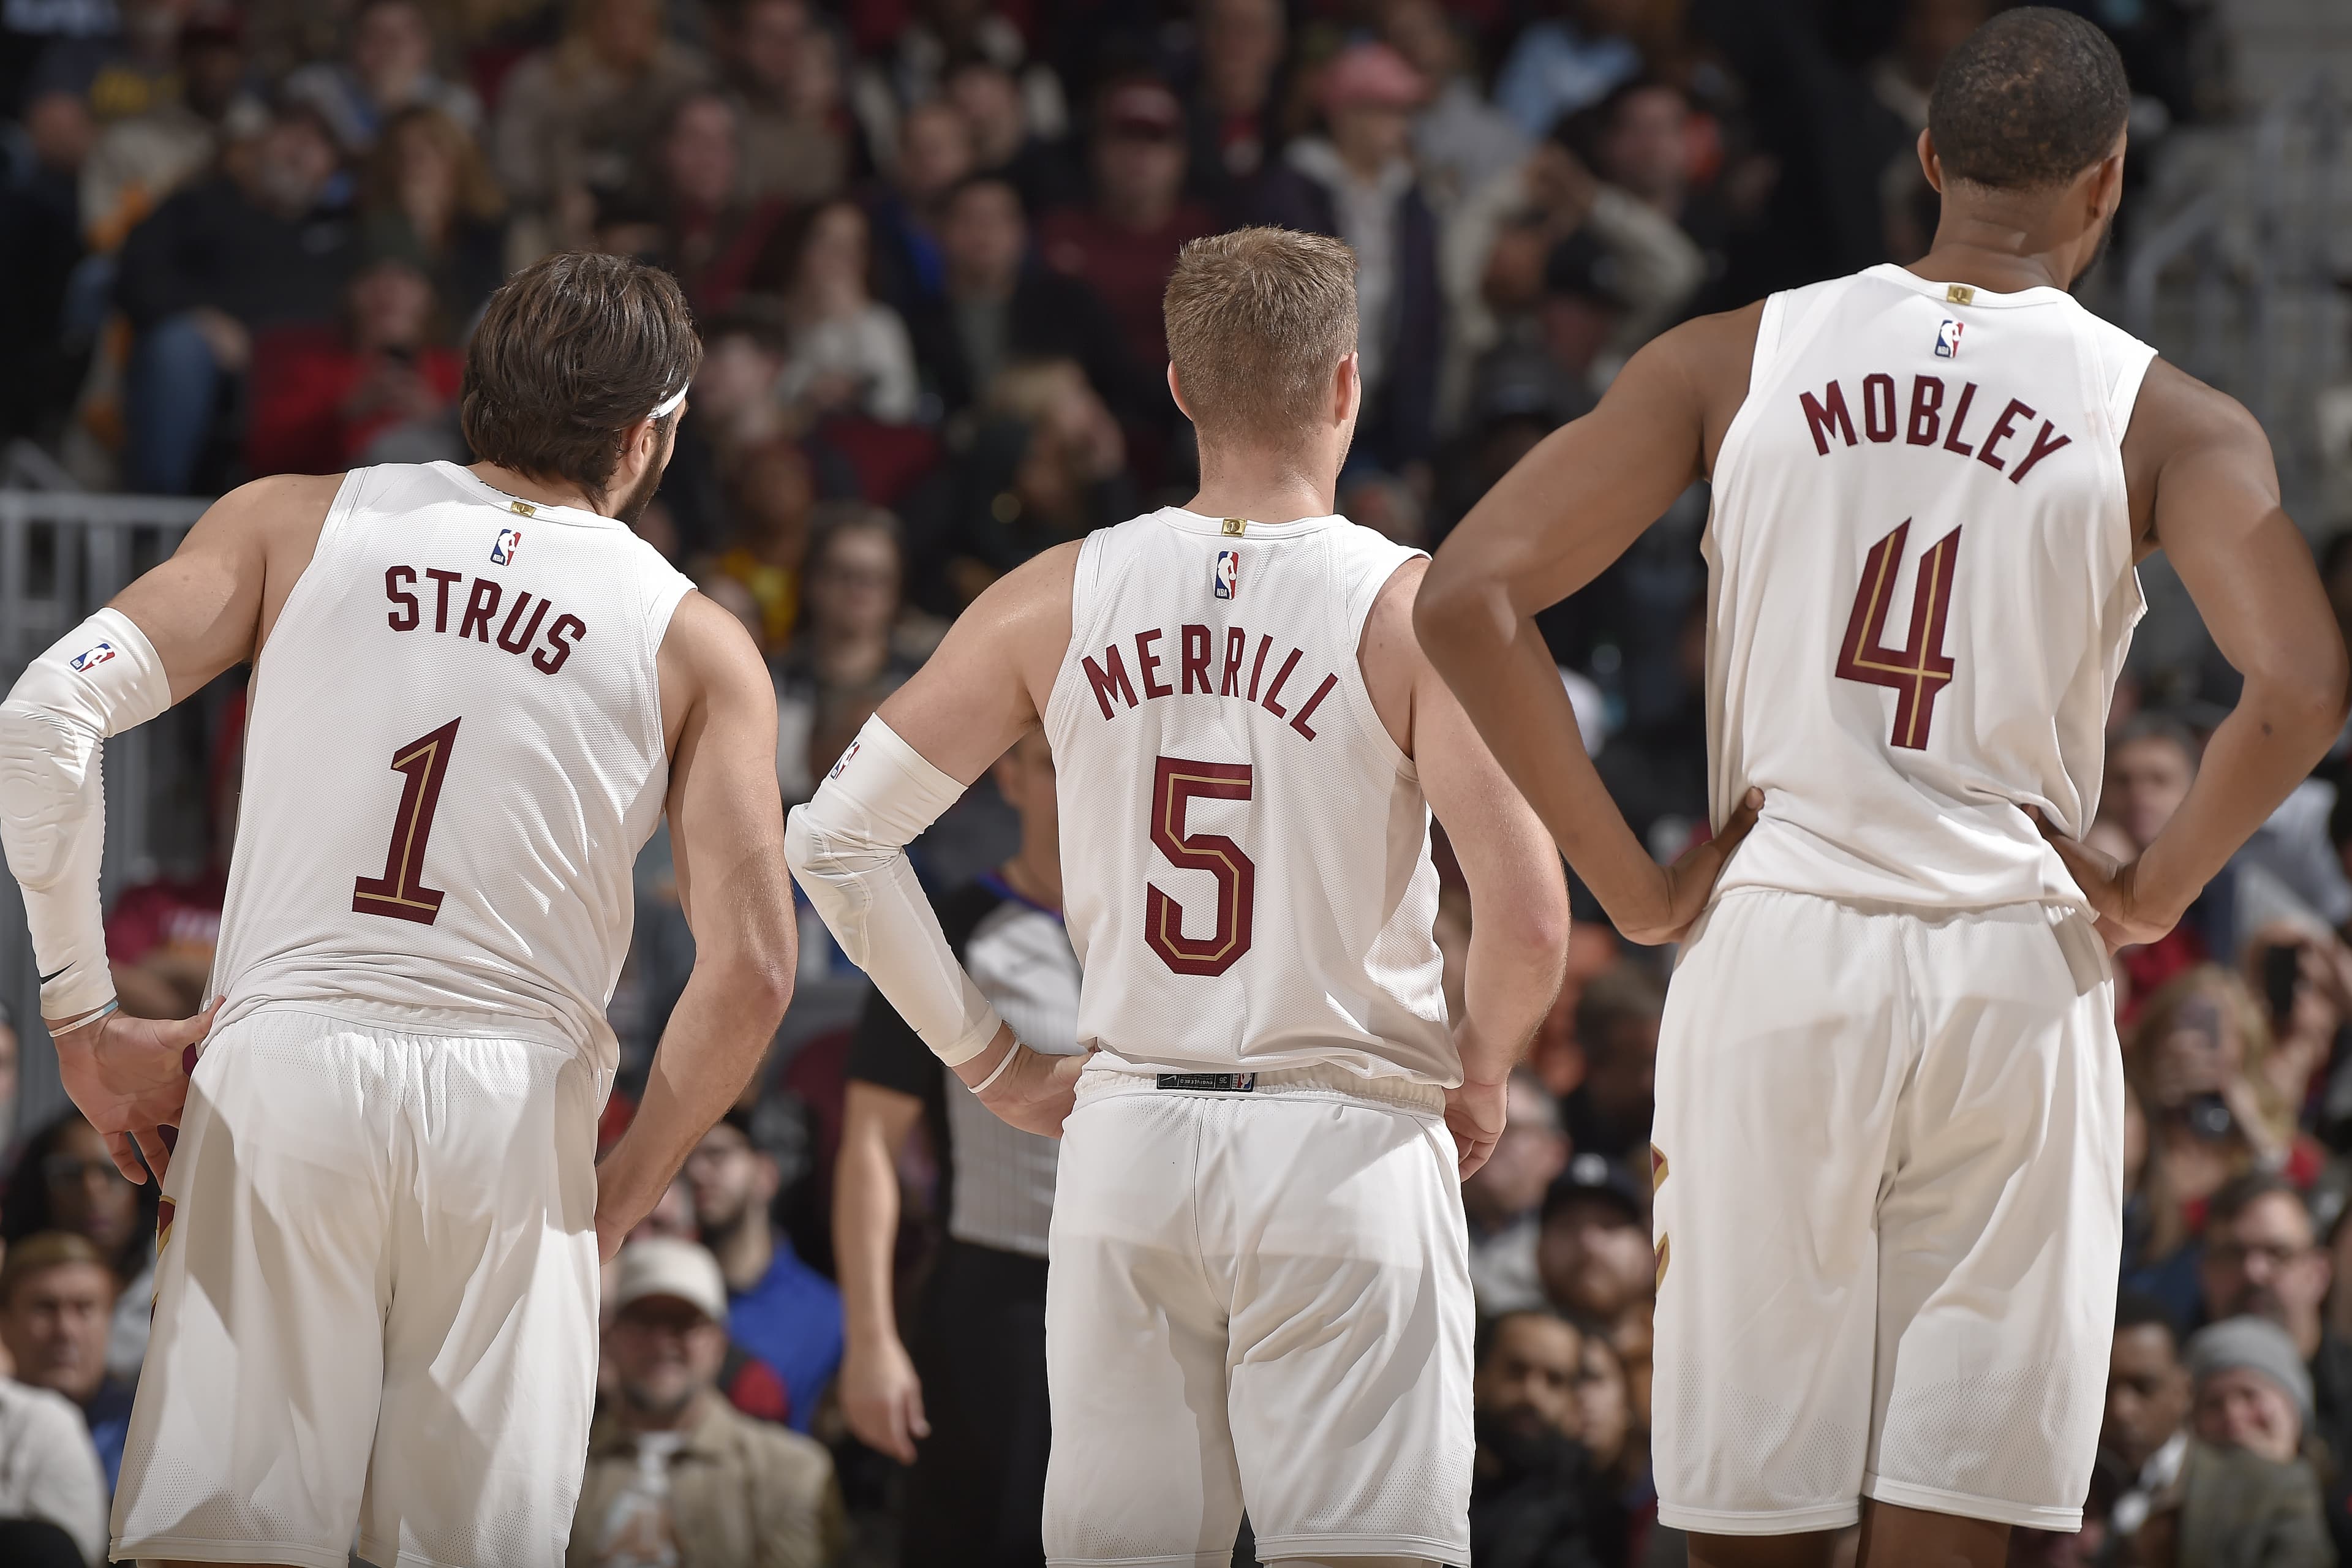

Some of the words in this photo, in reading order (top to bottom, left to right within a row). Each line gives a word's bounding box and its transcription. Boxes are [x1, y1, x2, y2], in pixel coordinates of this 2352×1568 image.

[1800, 374, 2071, 483] MOBLEY
[492, 554, 503, 562] NBA
[1216, 588, 1227, 597] NBA
[385, 566, 586, 675] STRUS
[1835, 517, 1961, 751] 4
[1082, 624, 1338, 741] MERRILL
[352, 717, 461, 925] 1
[1145, 756, 1255, 978] 5
